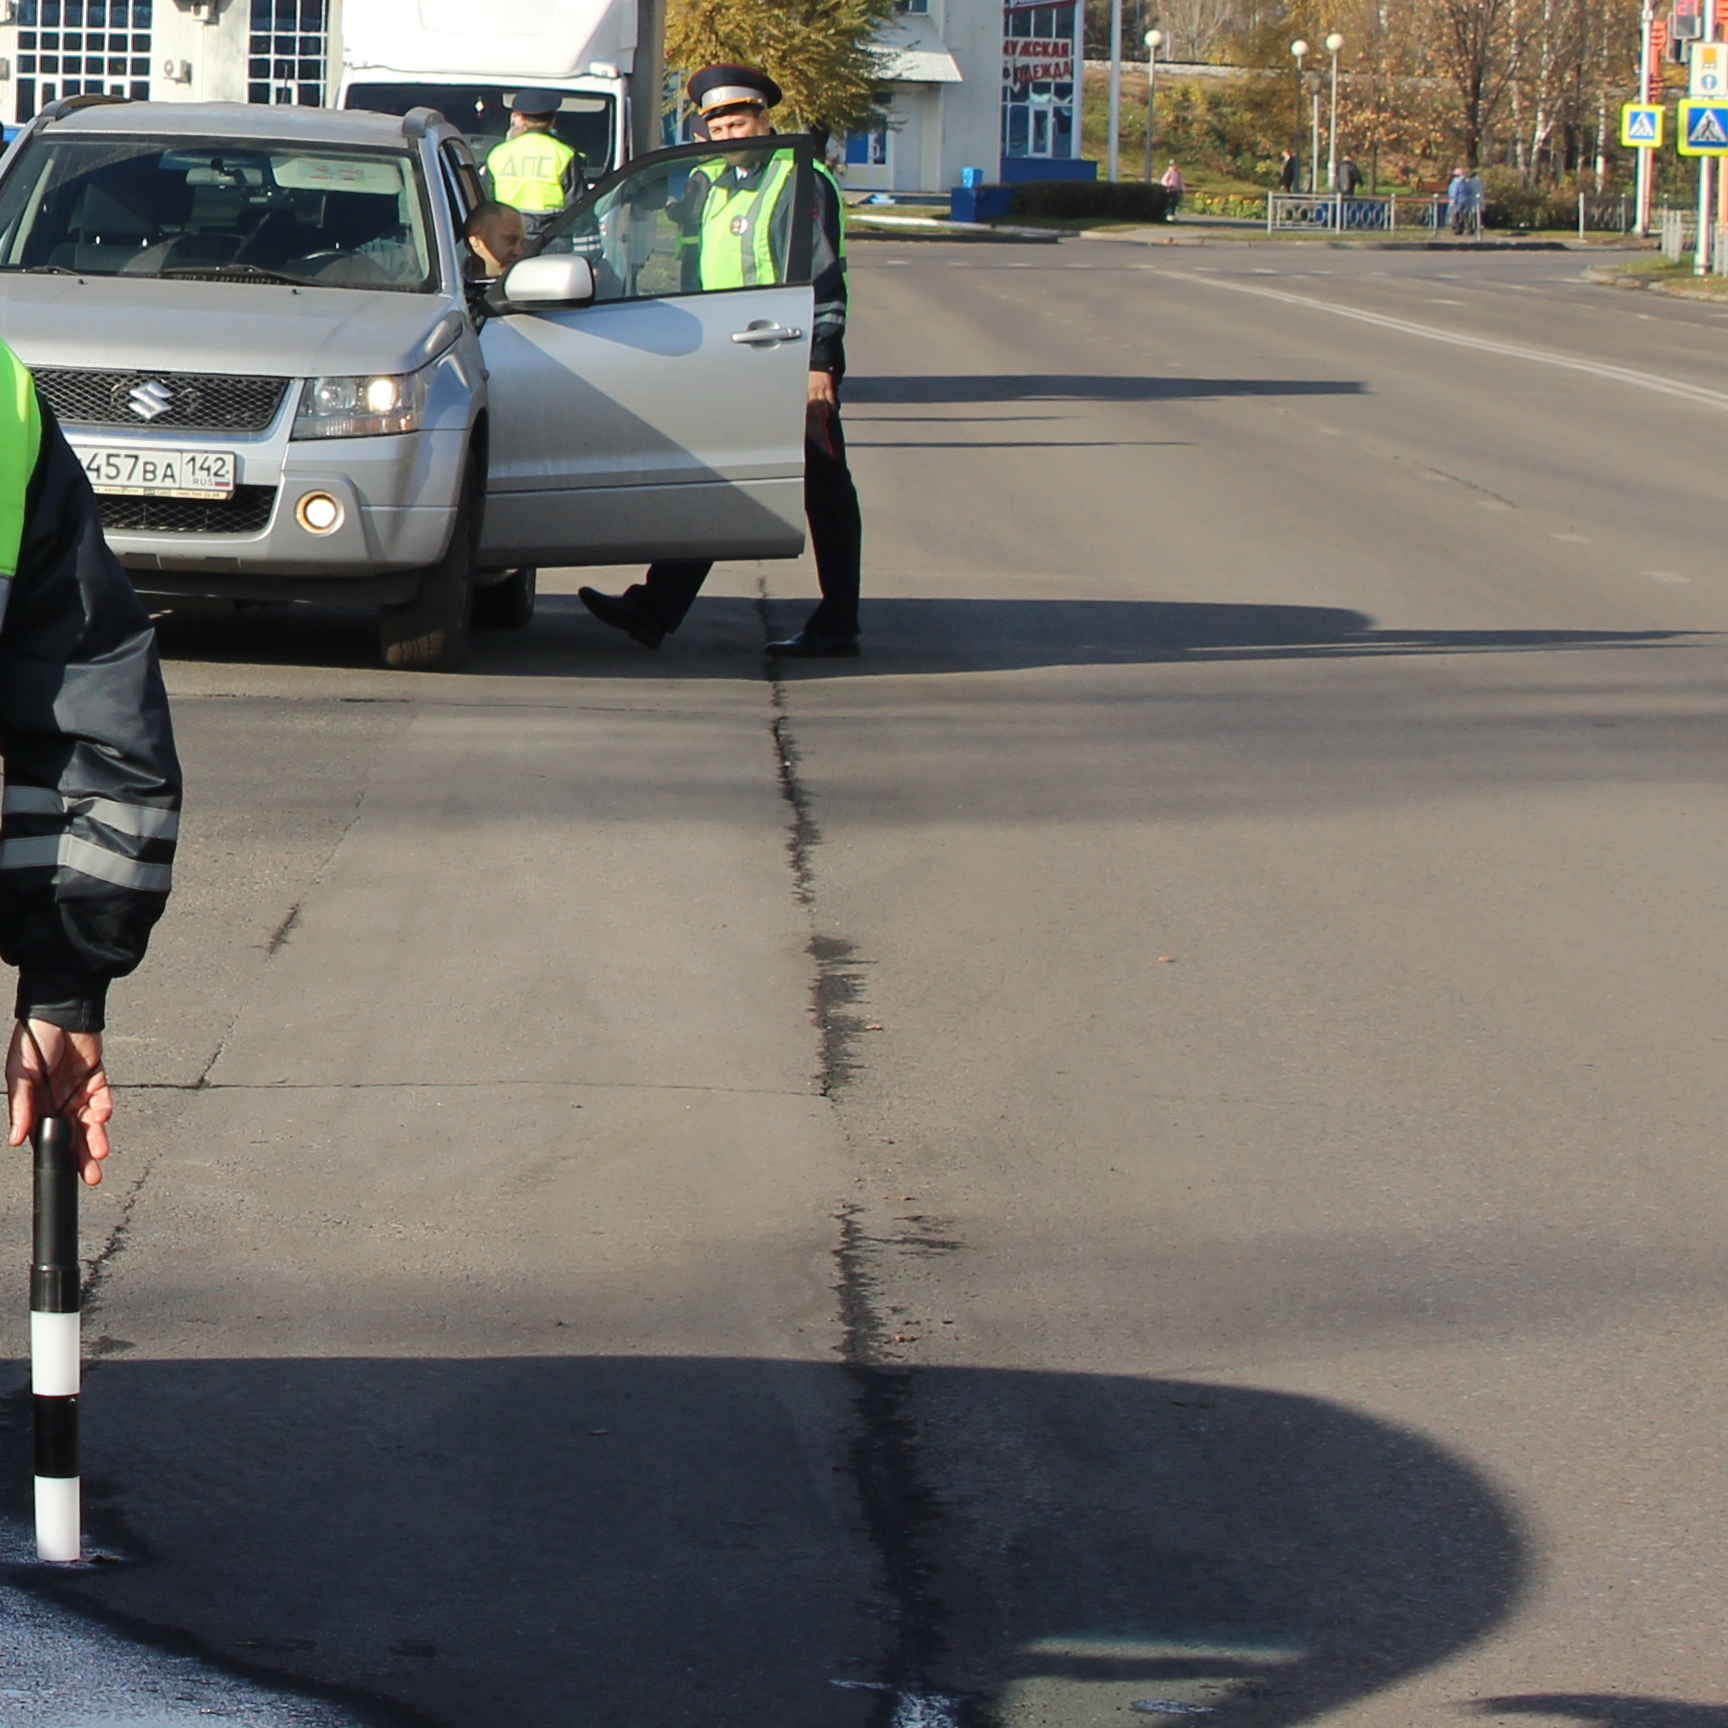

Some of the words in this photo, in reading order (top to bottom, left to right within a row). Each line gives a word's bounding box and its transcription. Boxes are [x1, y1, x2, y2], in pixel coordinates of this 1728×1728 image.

[499, 155, 553, 178] ДПС
[78, 452, 177, 484] 457ВА
[185, 455, 227, 478] 142
[193, 478, 214, 486] RUS
